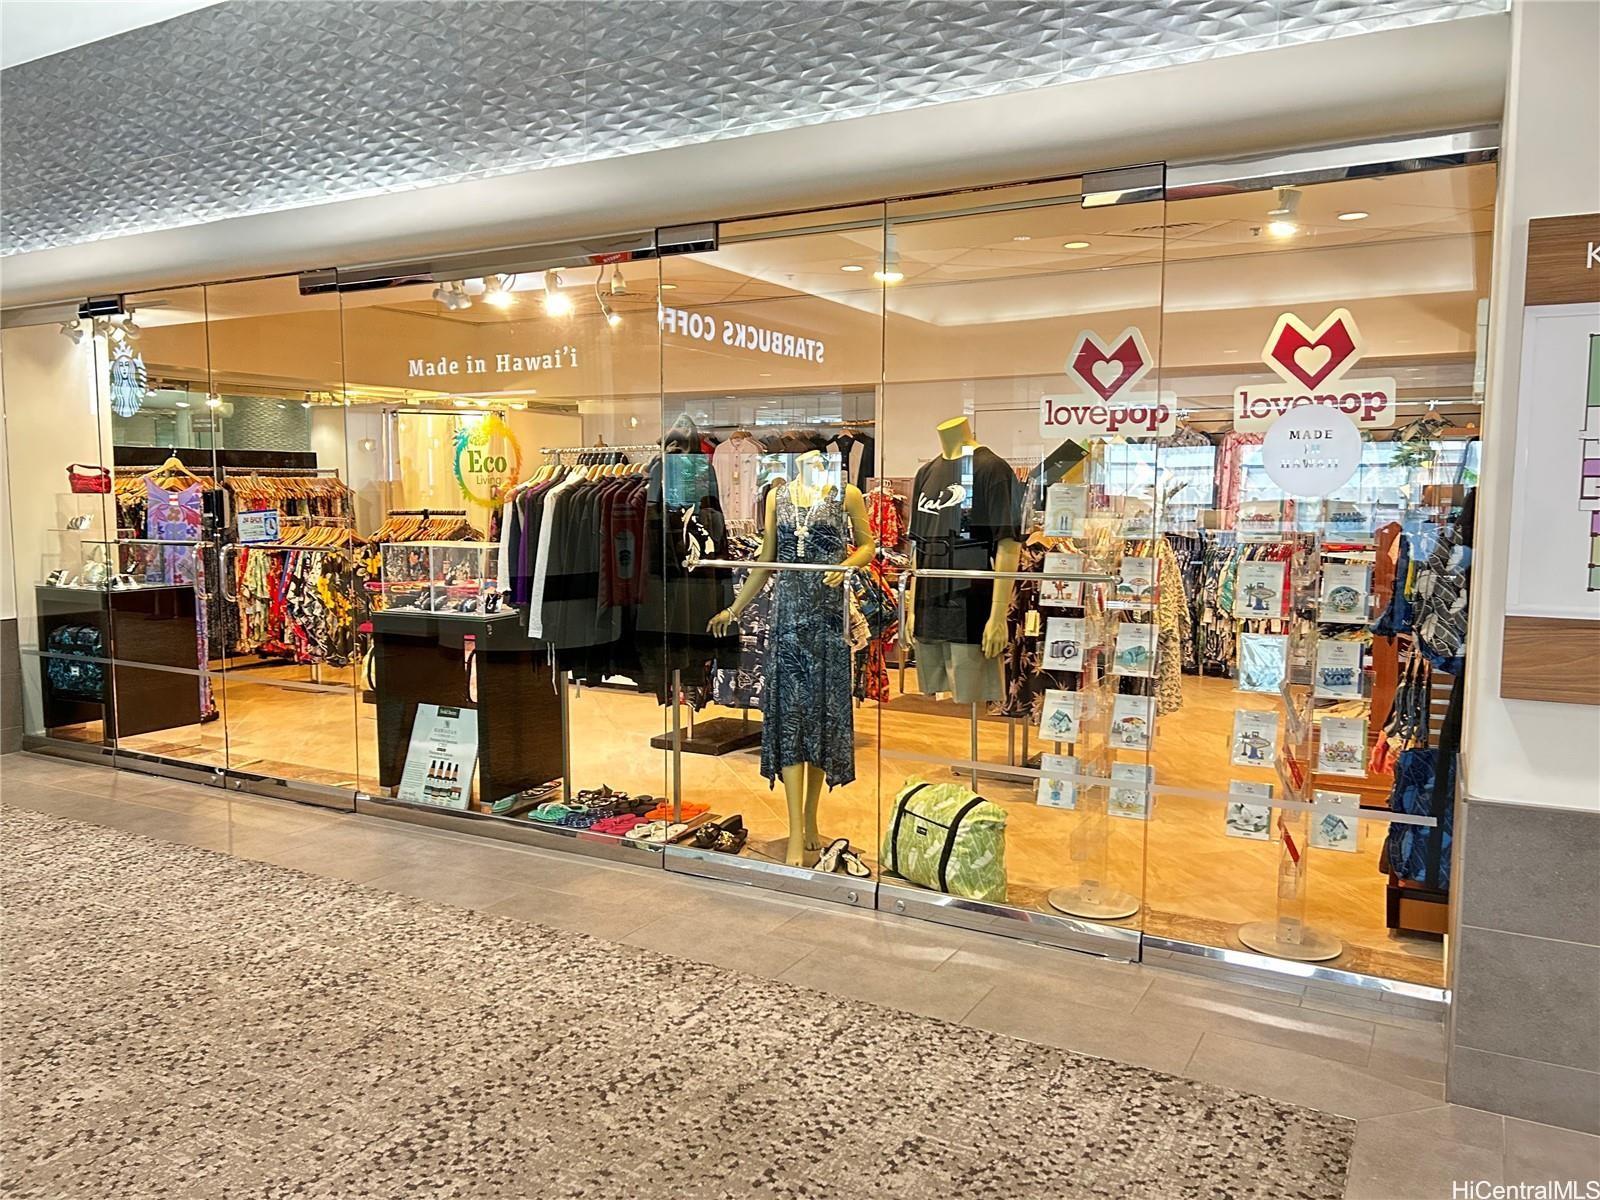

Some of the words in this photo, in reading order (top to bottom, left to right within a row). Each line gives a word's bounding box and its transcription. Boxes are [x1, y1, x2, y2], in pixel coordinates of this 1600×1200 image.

[408, 357, 460, 377] Made
[466, 355, 487, 374] in
[495, 345, 579, 373] Hawai'i
[1044, 400, 1170, 432] lovepop
[1289, 429, 1334, 440] MADE
[467, 450, 508, 473] Eco
[476, 475, 502, 485] Living
